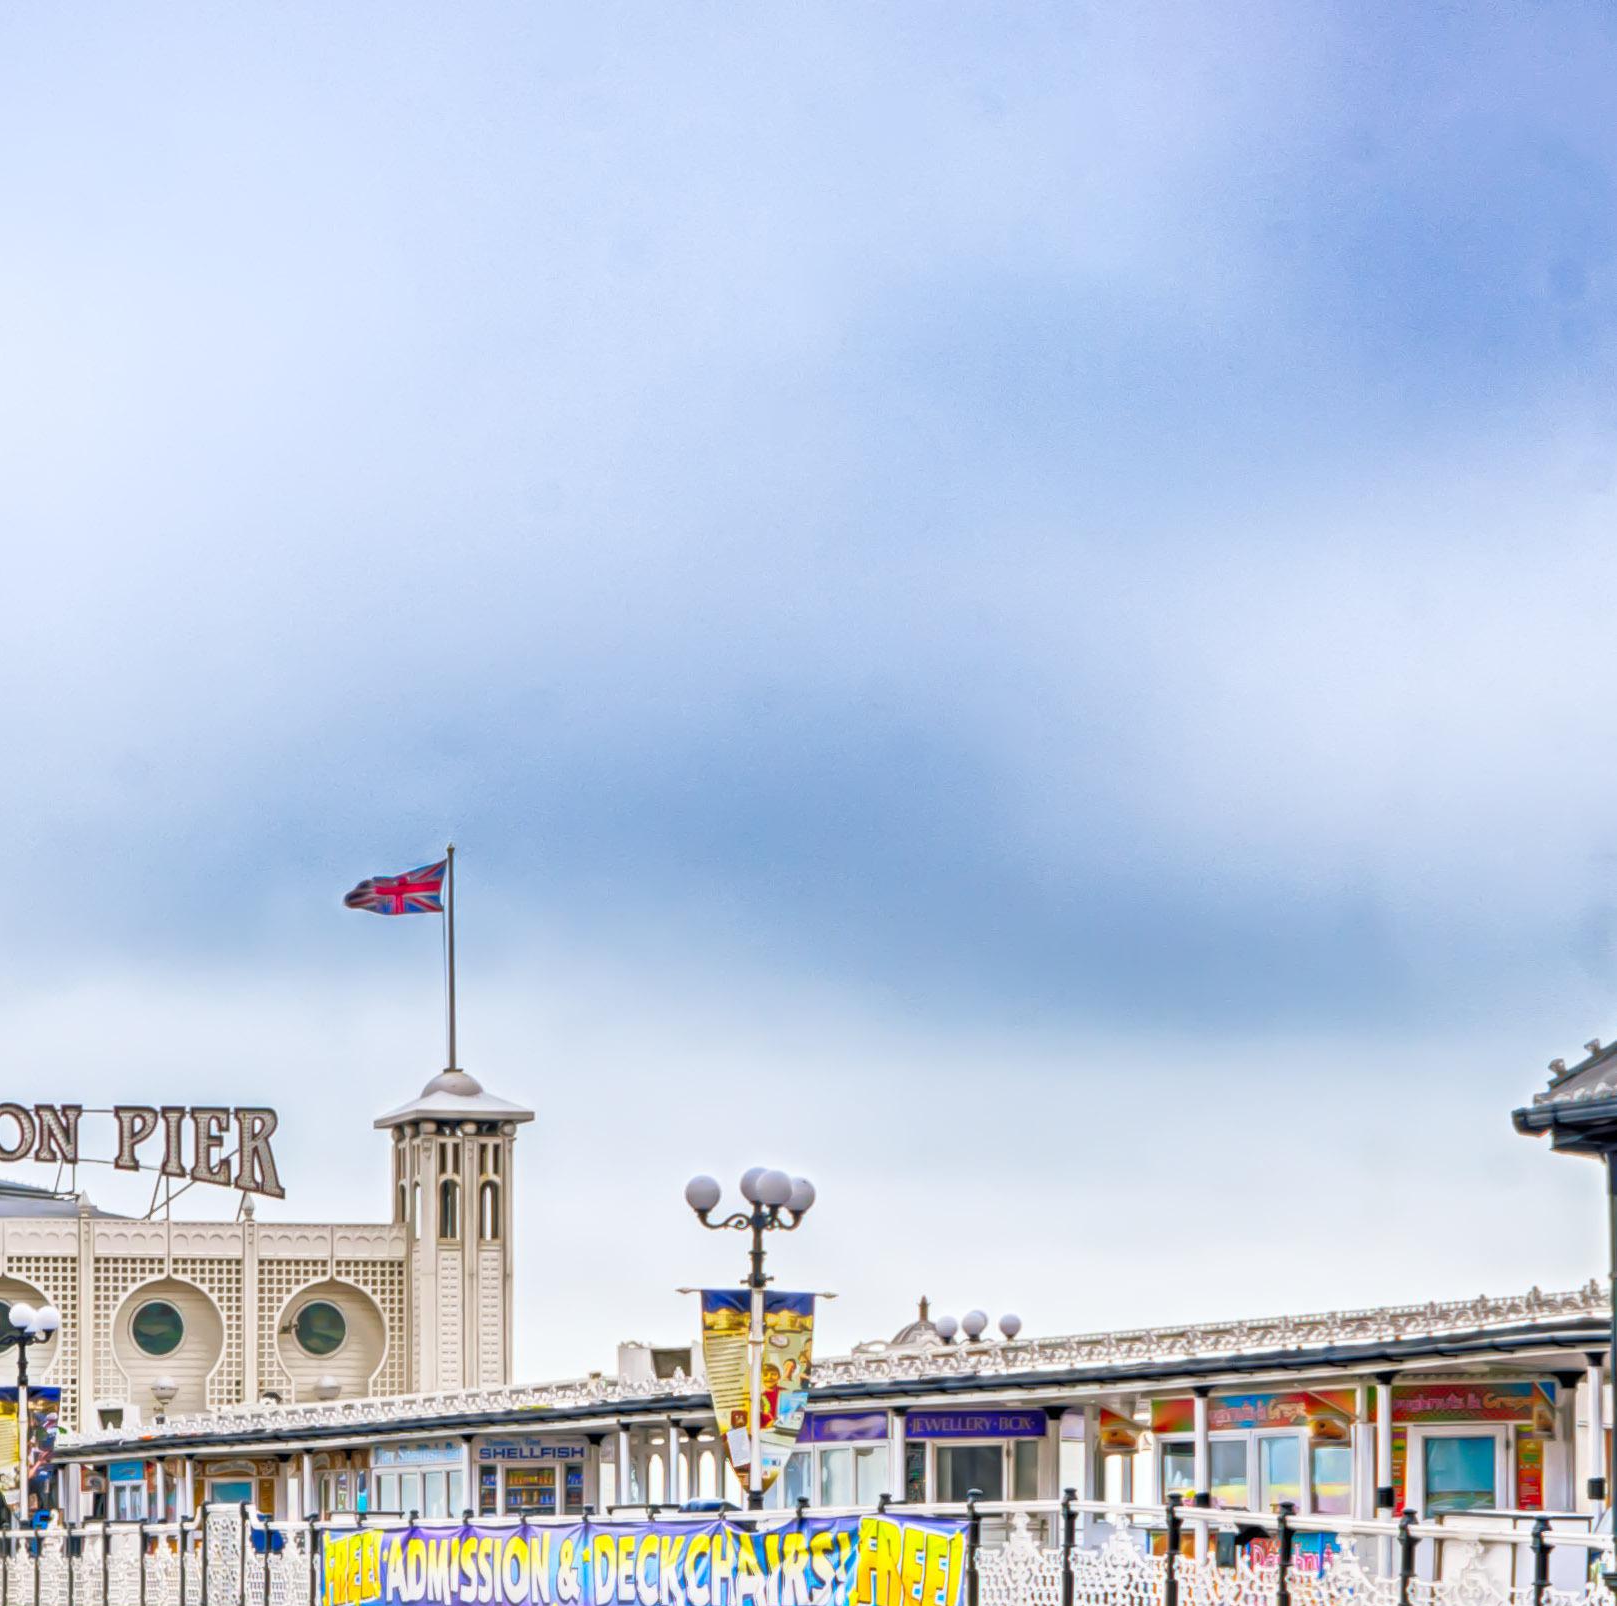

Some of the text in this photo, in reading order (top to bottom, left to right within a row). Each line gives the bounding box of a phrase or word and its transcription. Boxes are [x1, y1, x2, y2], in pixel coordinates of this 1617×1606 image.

[113, 1105, 286, 1199] PIER
[912, 1416, 1031, 1434] JEWELLERY BOX
[479, 1447, 584, 1459] SHELLFISH
[386, 1531, 551, 1606] ADMISSION
[556, 1538, 581, 1602] &
